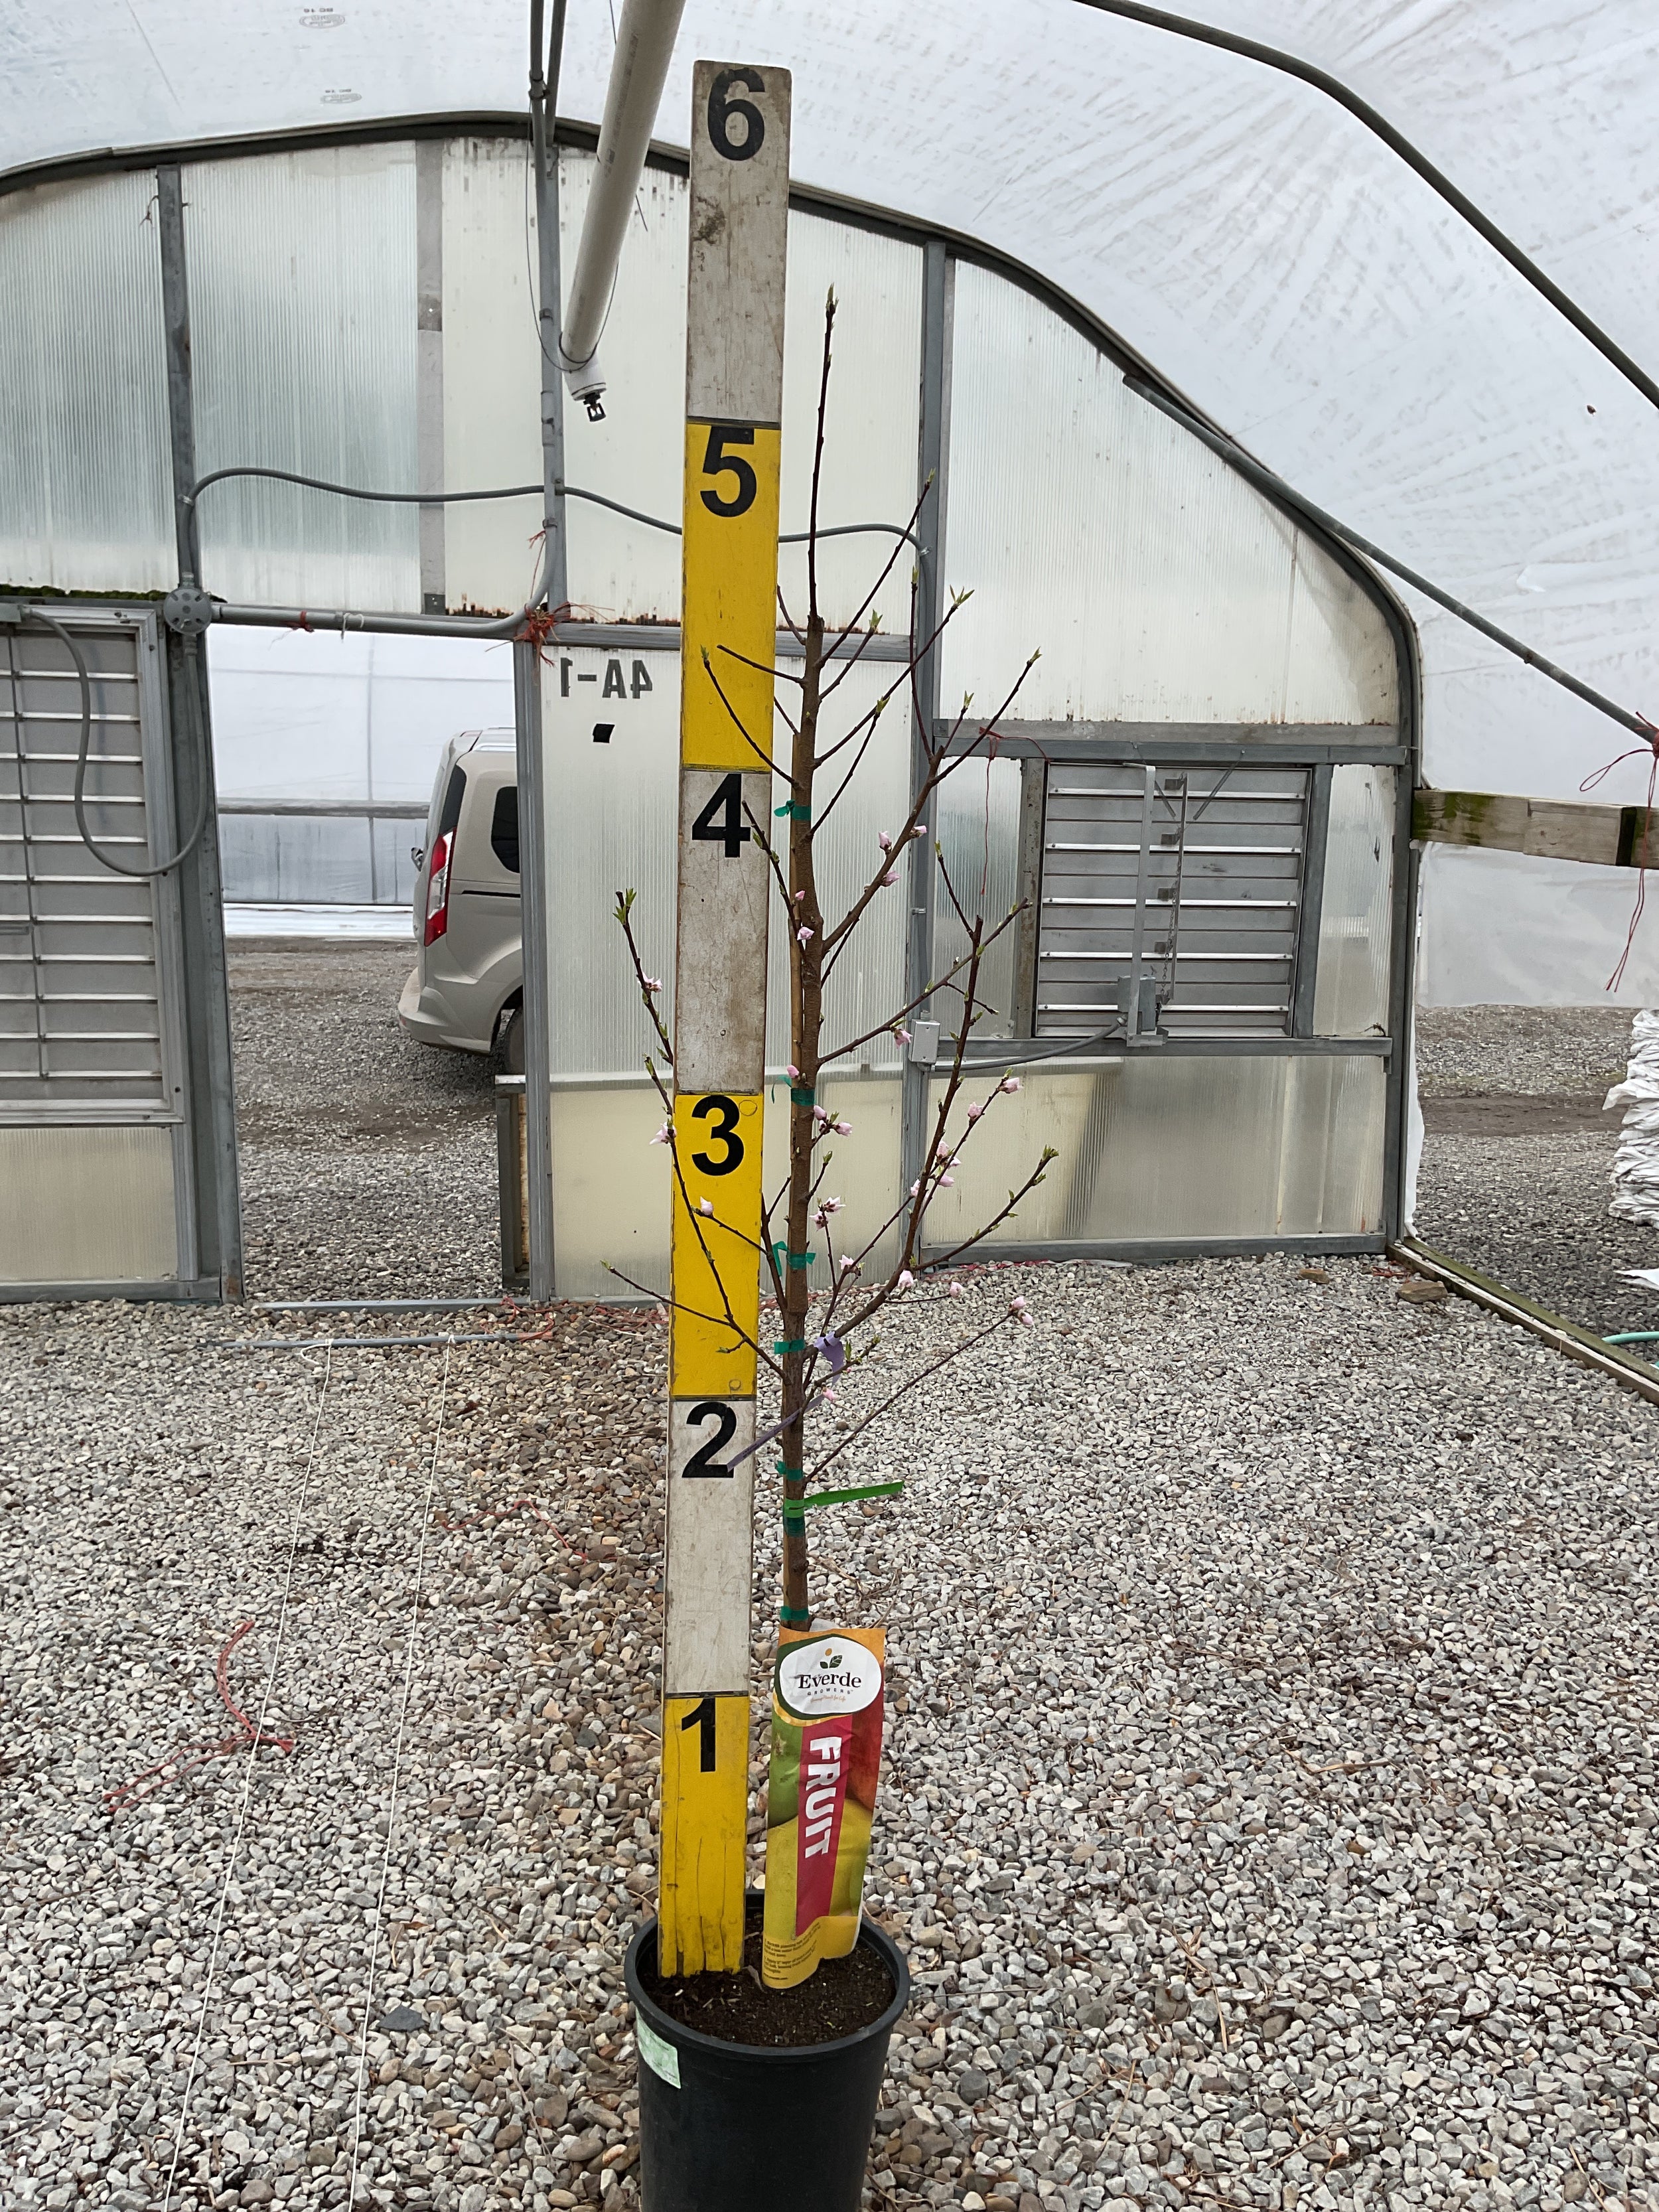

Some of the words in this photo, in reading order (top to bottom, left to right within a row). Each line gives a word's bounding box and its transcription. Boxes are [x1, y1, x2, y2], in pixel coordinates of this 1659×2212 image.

[707, 67, 765, 161] 6
[699, 425, 757, 518] 5
[691, 773, 751, 857] 4
[691, 1095, 745, 1177] 3
[682, 1401, 737, 1478] 2
[798, 1672, 861, 1689] Everde
[681, 1698, 716, 1773] 1
[805, 1736, 842, 1858] FRUIT
